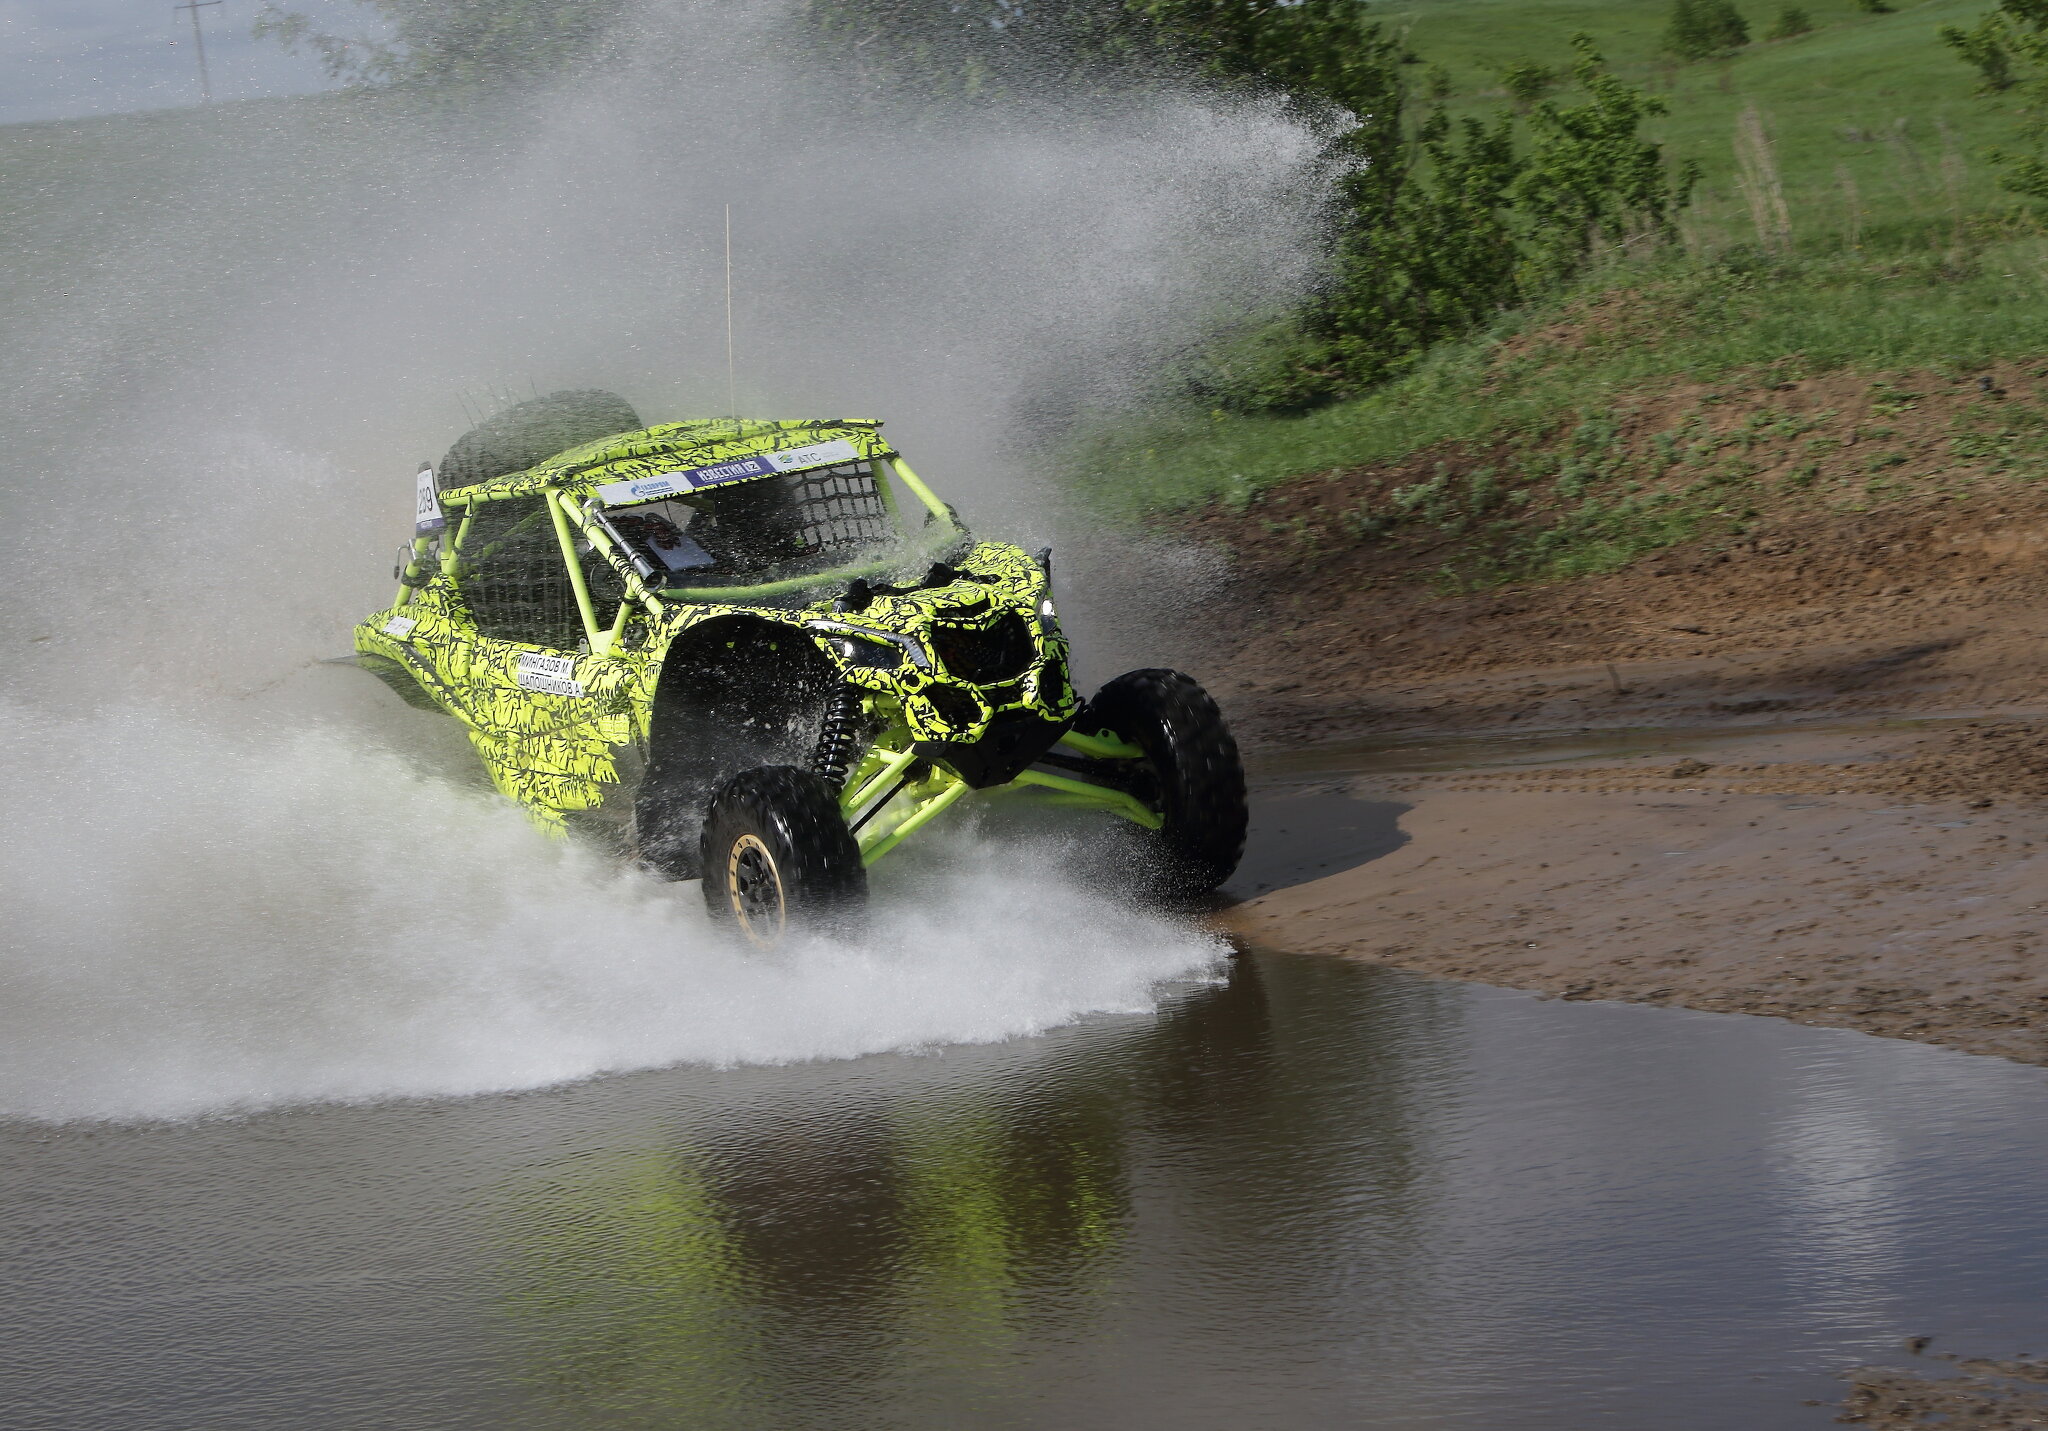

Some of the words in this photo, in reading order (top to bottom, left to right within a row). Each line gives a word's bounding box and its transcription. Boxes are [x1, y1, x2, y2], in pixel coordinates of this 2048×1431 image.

[696, 464, 746, 481] ИЗВЕСТИЯ
[519, 653, 561, 673] МИНГАЗОВ
[518, 673, 573, 695] ШАПОШНИКОВ
